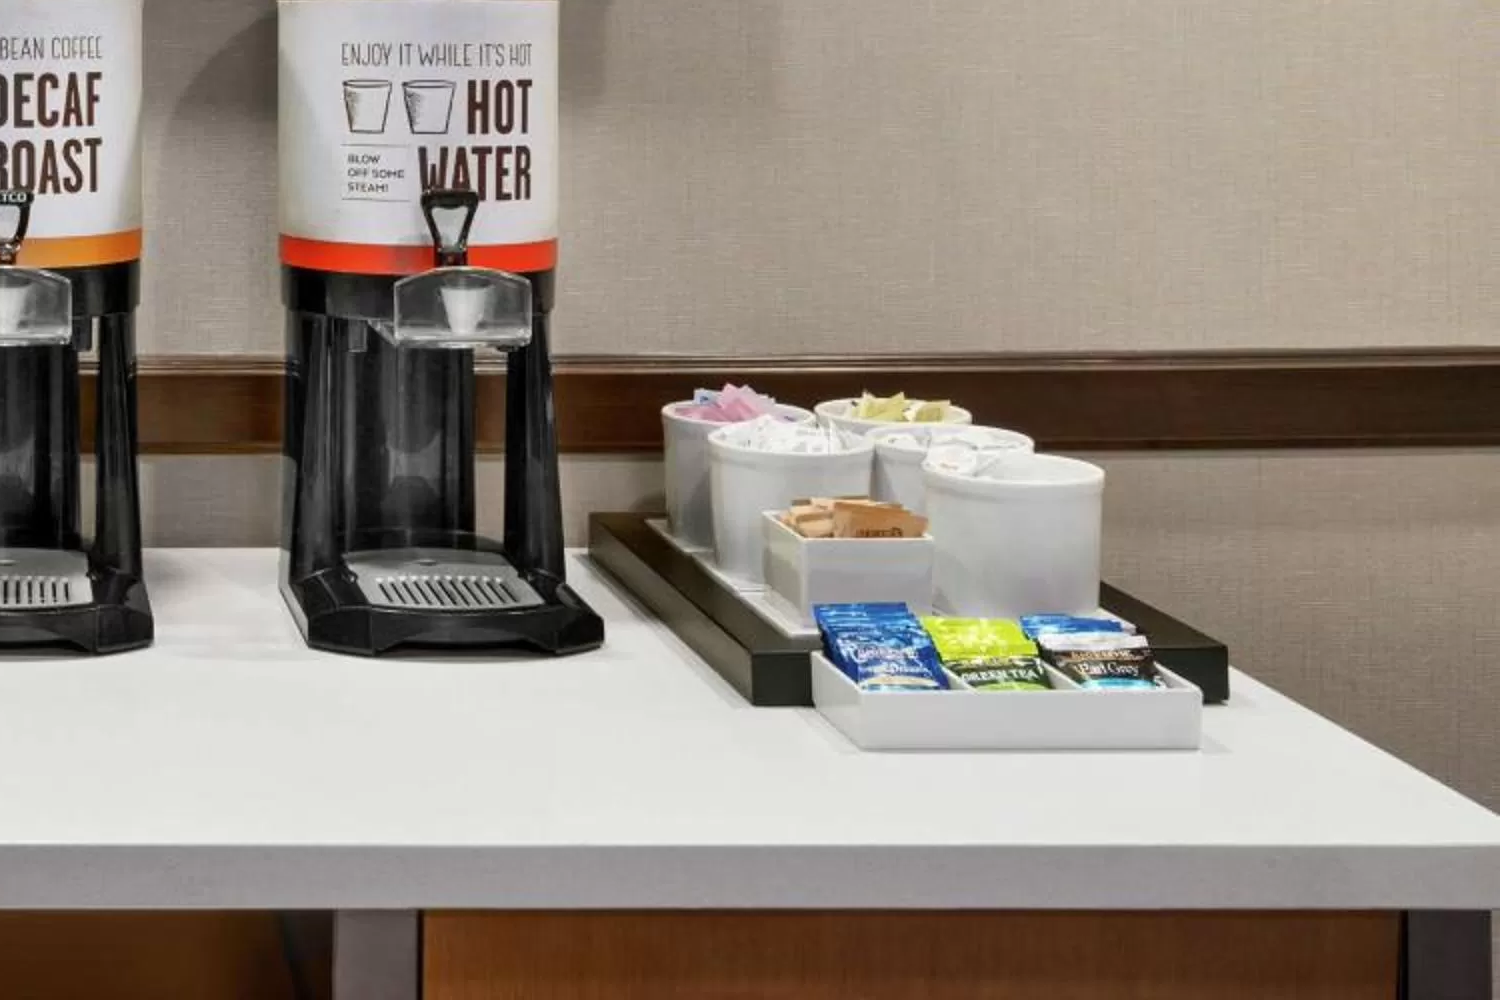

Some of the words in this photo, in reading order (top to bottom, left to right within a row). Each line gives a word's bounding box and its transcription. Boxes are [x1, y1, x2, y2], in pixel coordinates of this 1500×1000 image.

[0, 37, 44, 60] BEAN
[52, 36, 102, 59] COFFEE
[341, 43, 392, 66] ENJOY
[400, 43, 412, 66] IT
[416, 44, 472, 66] WHILE
[479, 43, 505, 66] IT'S
[509, 43, 532, 66] HOT
[467, 79, 533, 135] HOT
[372, 168, 404, 179] SOME
[418, 145, 531, 201] WATER
